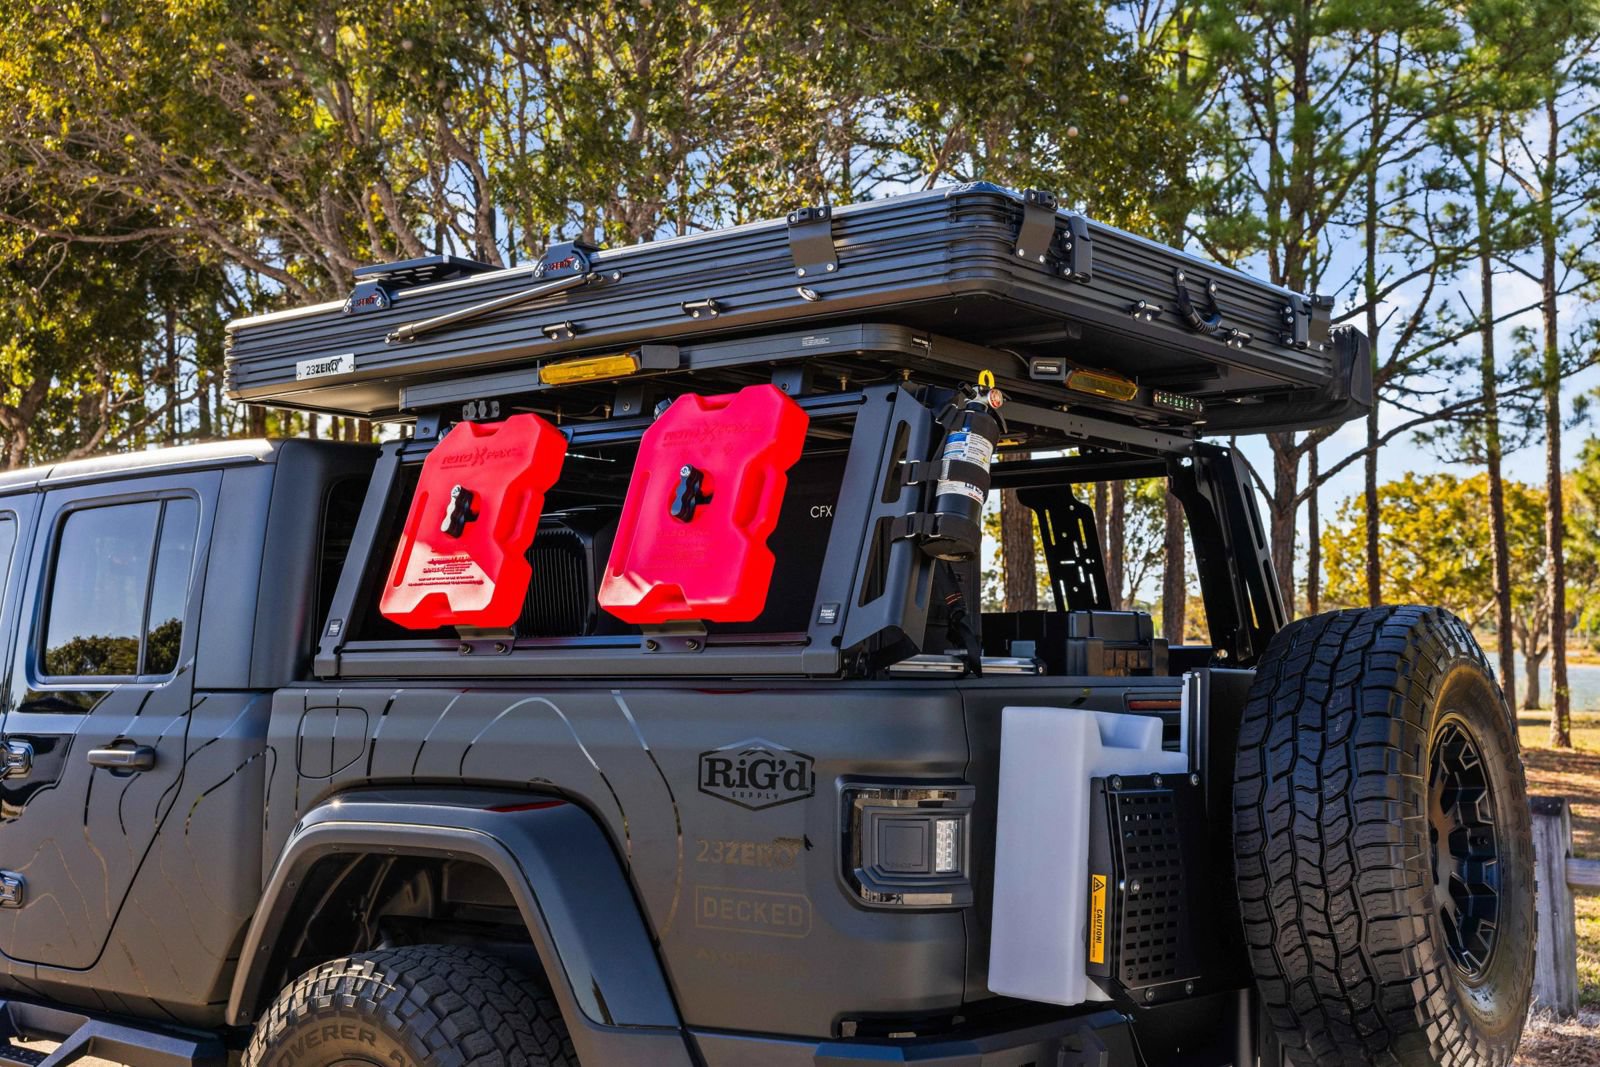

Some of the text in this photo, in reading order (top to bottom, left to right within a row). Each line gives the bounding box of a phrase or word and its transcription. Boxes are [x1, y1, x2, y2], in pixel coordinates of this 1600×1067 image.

[306, 358, 340, 376] 23ZERO
[810, 505, 833, 518] CFX
[704, 758, 808, 791] RiG'd
[731, 791, 780, 800] SUPPLY
[697, 838, 800, 869] 23ZERO
[703, 896, 803, 926] DECKED
